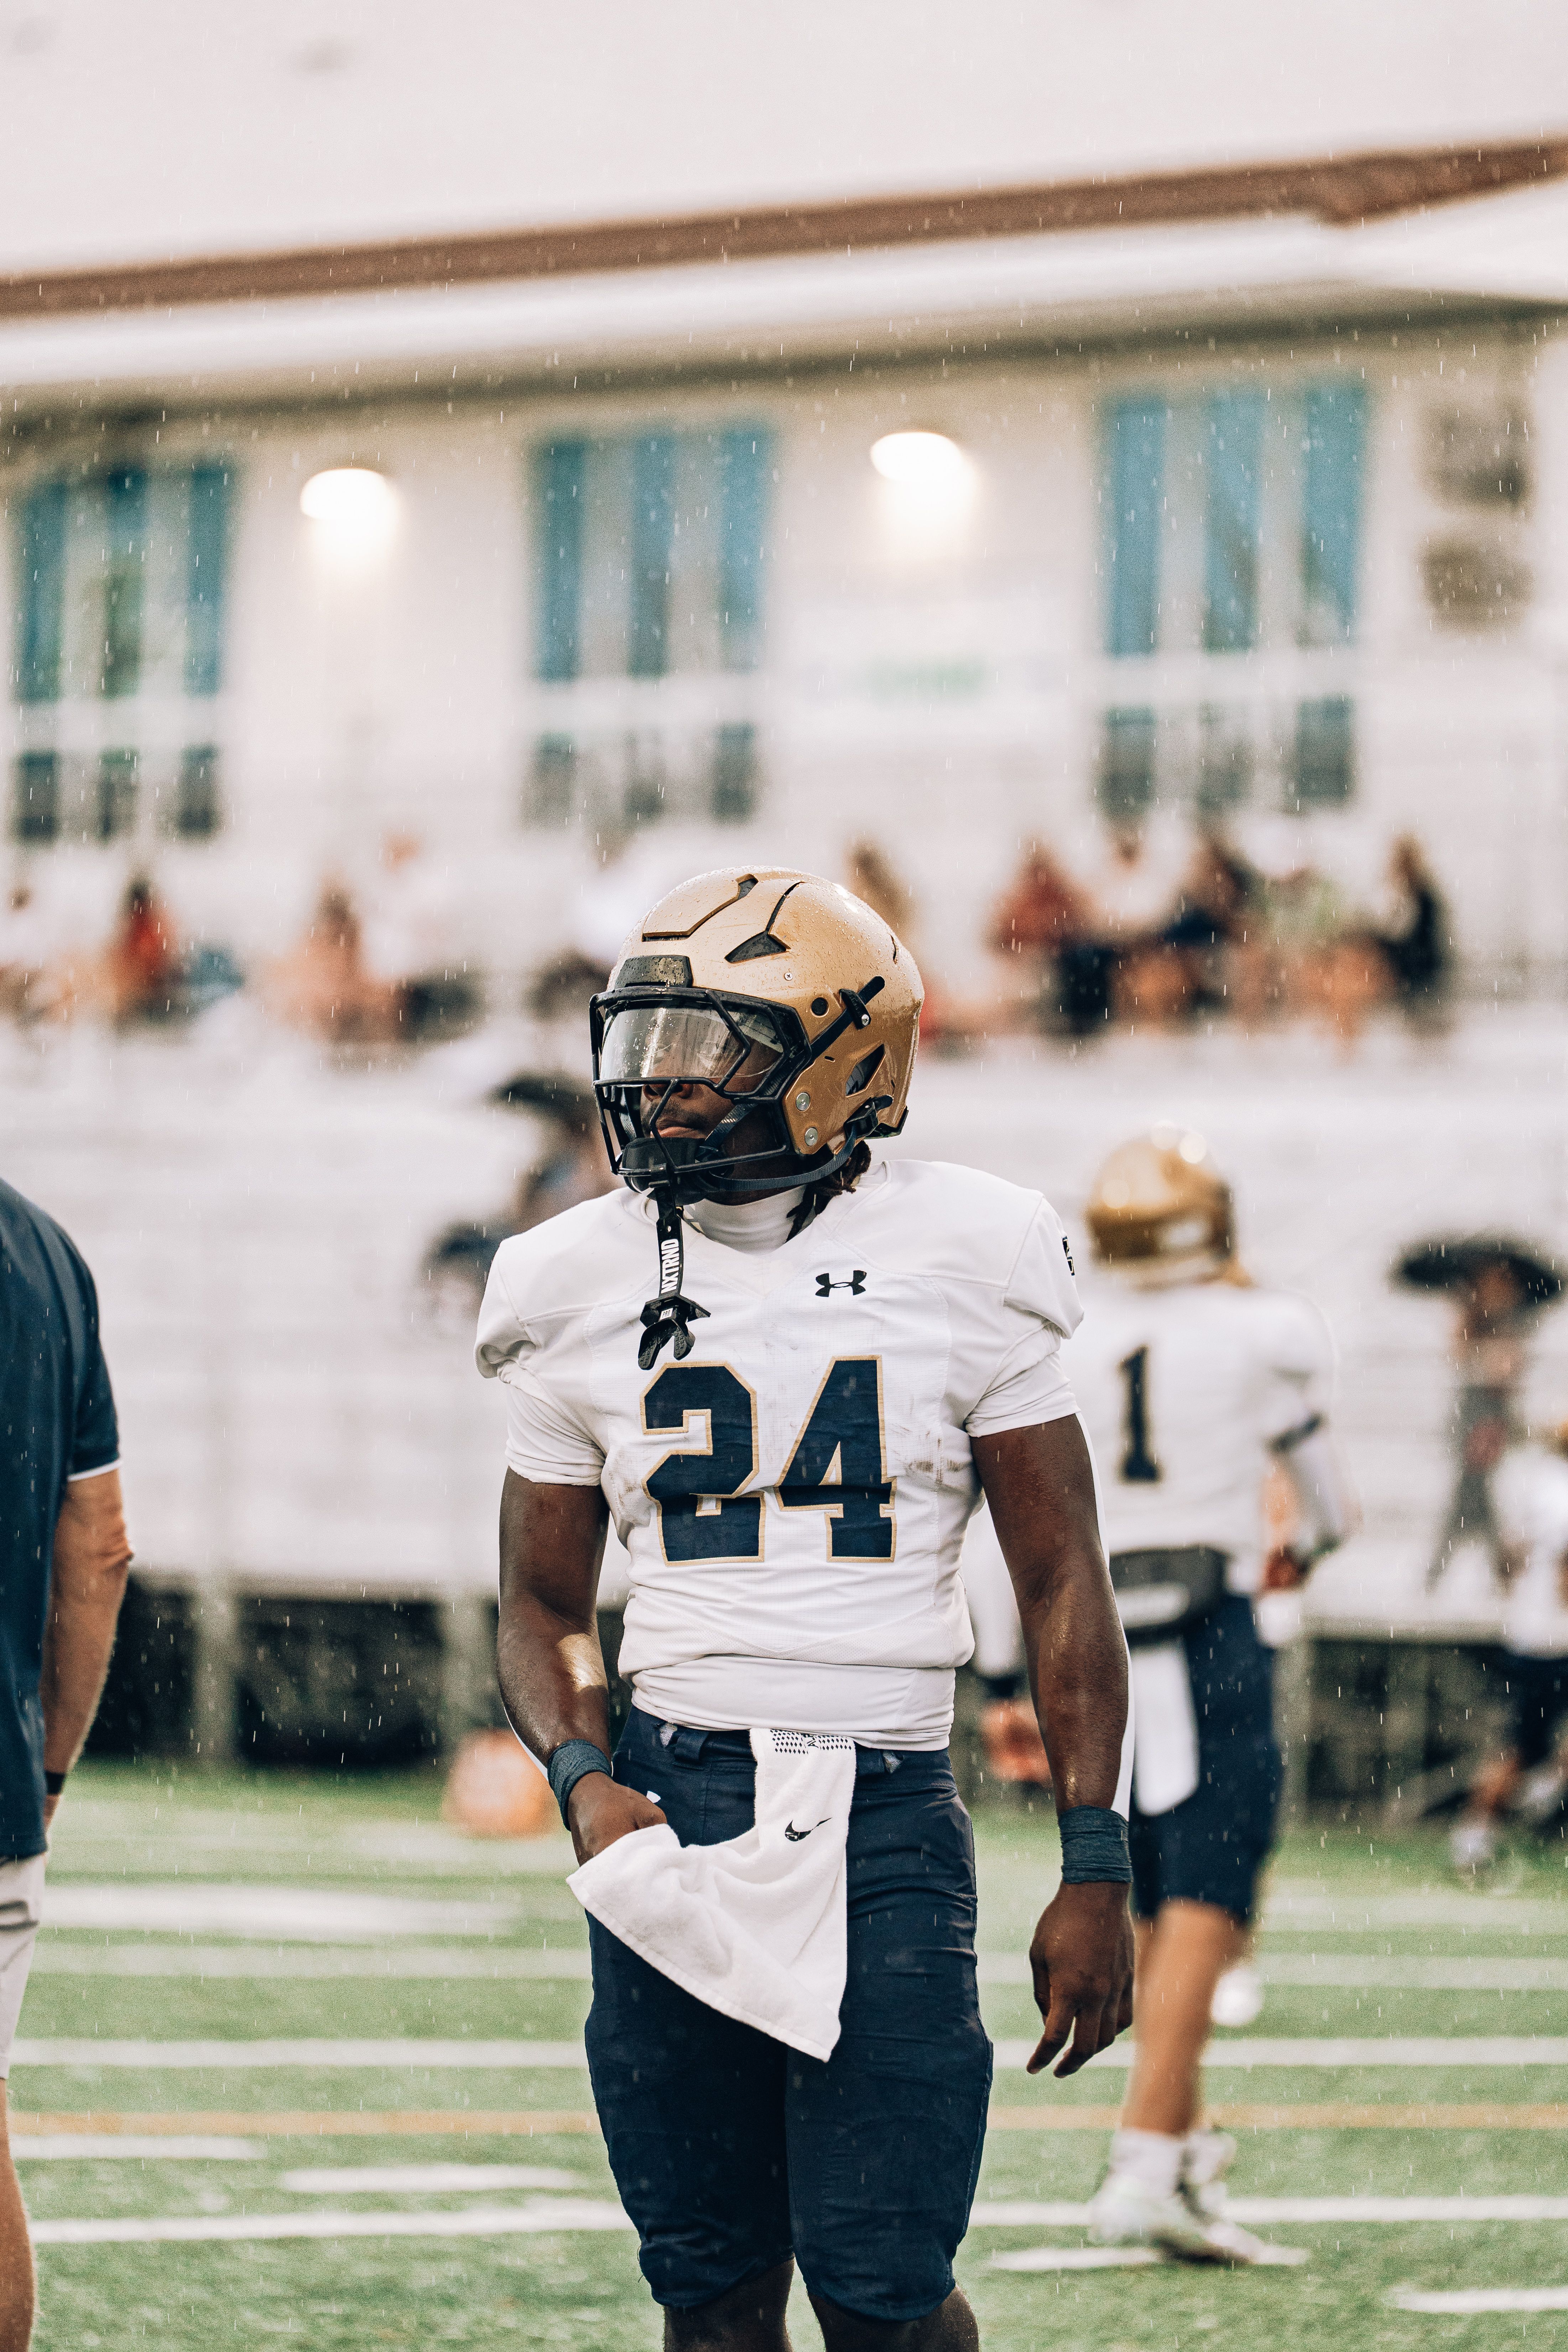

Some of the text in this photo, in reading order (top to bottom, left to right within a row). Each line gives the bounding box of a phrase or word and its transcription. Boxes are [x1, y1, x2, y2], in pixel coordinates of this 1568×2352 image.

[661, 1239, 679, 1294] NXTRND
[639, 1355, 897, 1566] 24
[1118, 1343, 1164, 1484] 1
